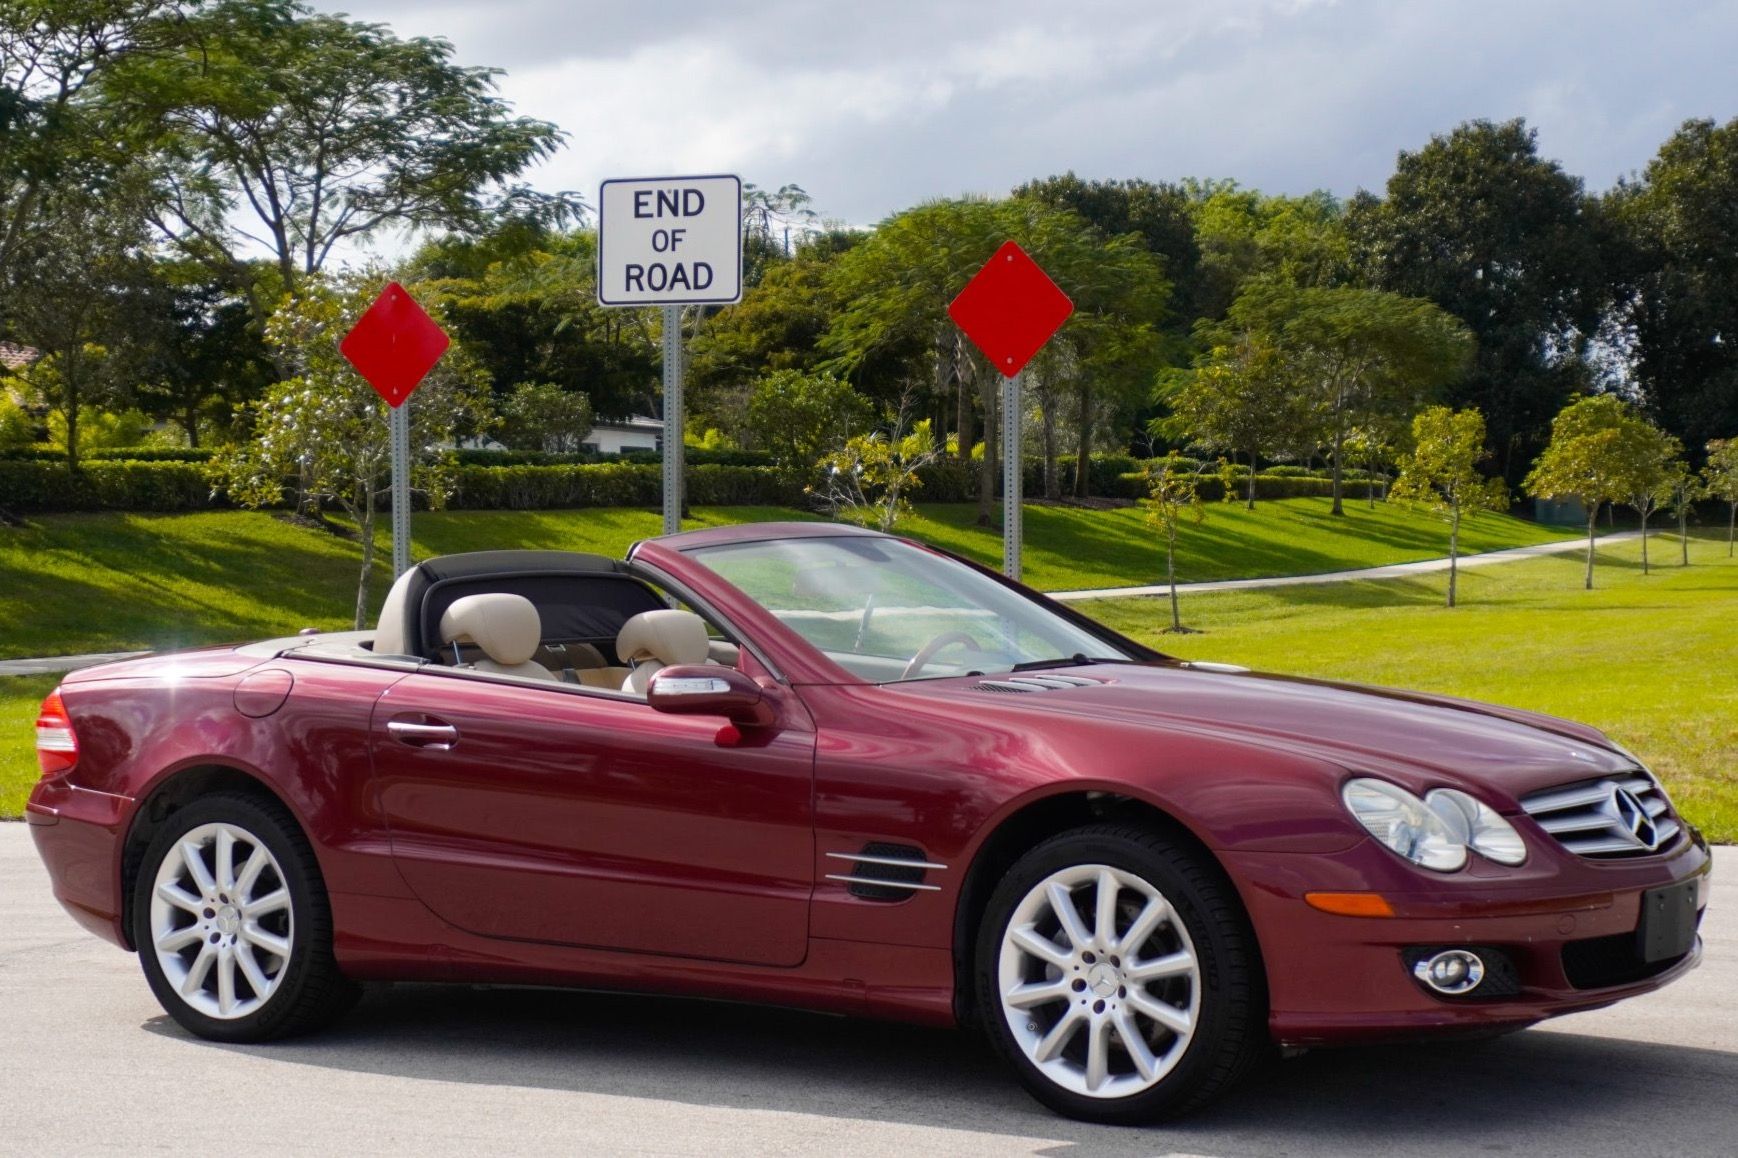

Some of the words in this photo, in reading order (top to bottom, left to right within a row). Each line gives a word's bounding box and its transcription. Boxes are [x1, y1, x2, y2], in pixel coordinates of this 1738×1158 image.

[634, 189, 705, 218] END
[652, 229, 686, 252] OF
[625, 262, 713, 292] ROAD
